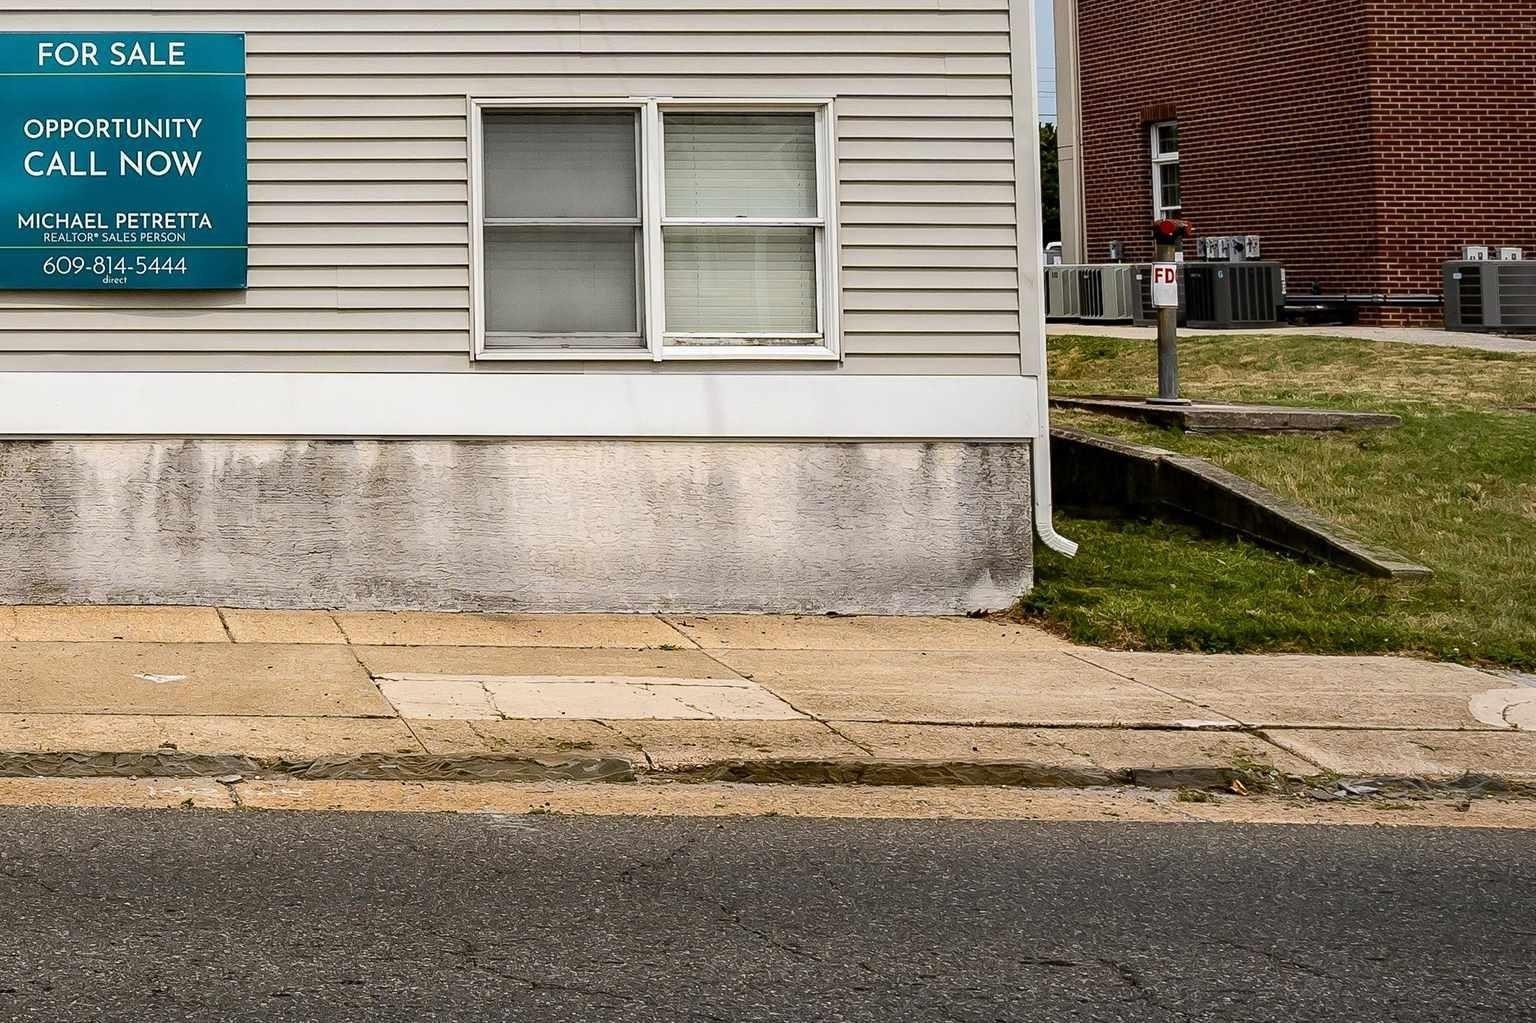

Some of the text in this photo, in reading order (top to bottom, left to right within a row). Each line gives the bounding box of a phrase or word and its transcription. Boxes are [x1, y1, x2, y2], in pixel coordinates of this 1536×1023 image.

[38, 42, 186, 66] FOR SALE
[23, 118, 203, 139] OPPORTUNITY
[24, 150, 202, 176] CALL NOW
[17, 213, 212, 229] MICHAEL PETRETTA
[102, 232, 137, 242] SALES
[140, 232, 186, 242] PERSON
[43, 256, 187, 275] 609-814-5444
[102, 275, 128, 284] direct
[1154, 268, 1175, 284] FD
